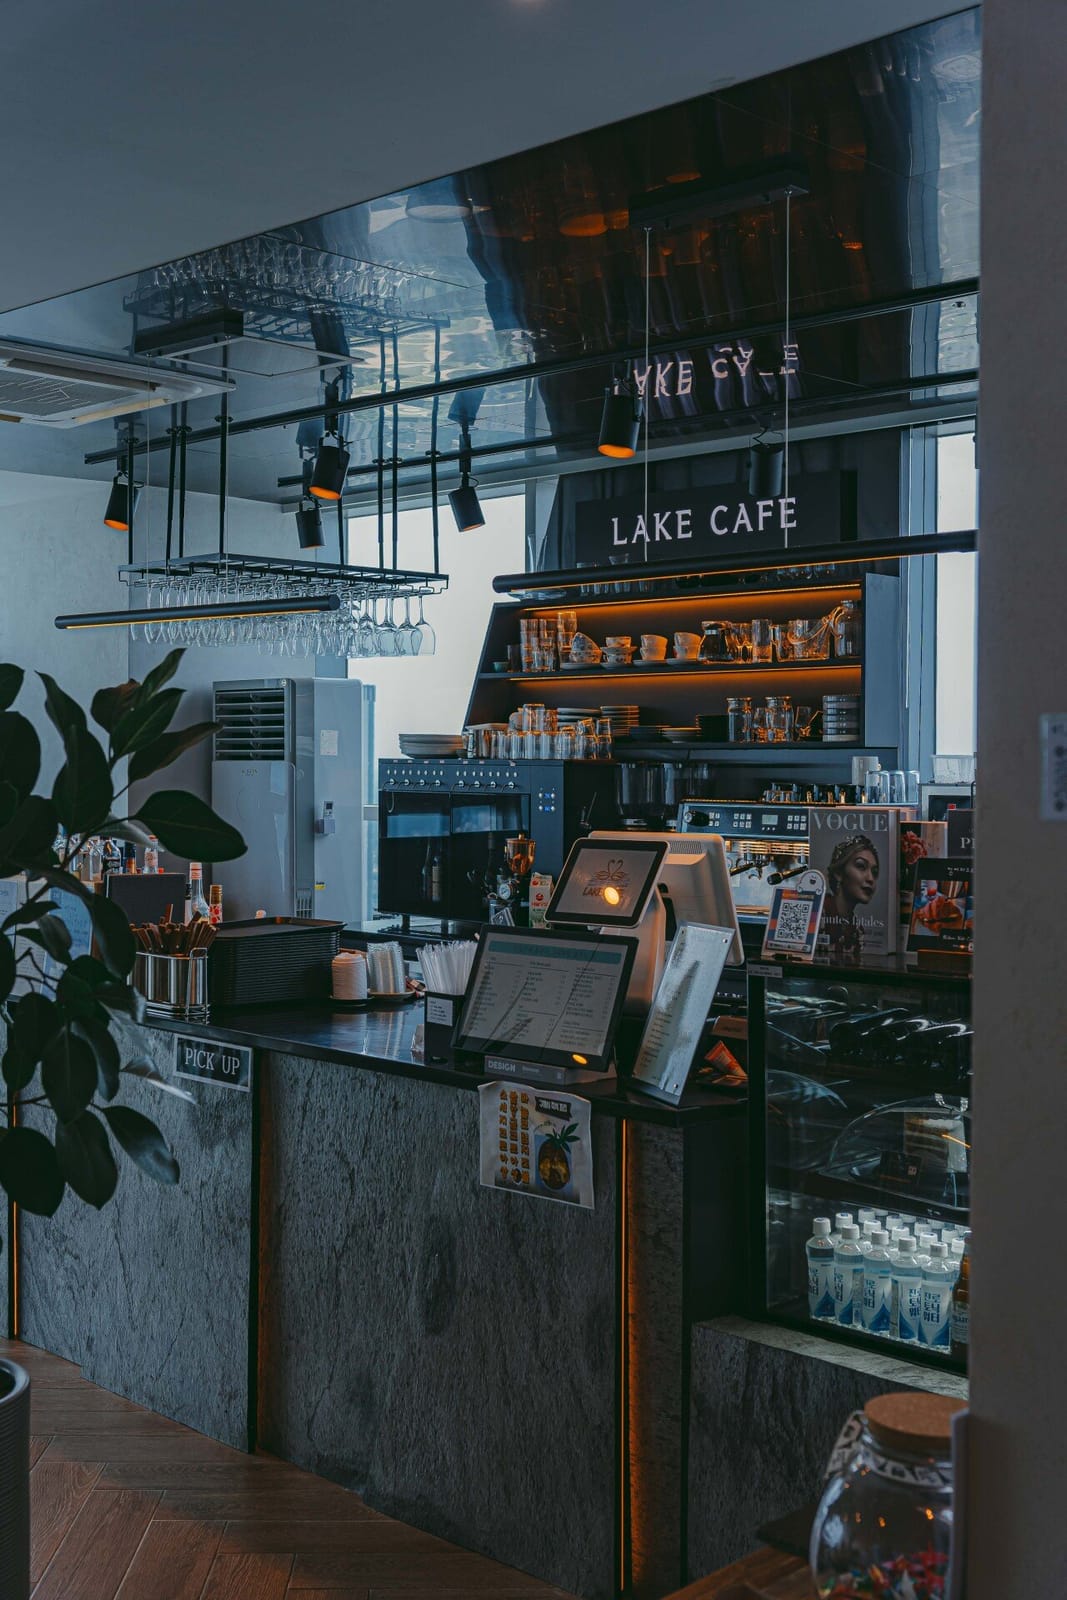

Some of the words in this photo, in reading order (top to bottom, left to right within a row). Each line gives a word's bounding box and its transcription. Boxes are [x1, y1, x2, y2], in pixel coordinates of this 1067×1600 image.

[611, 509, 692, 545] LAKE
[709, 497, 797, 536] CAFE
[812, 811, 888, 832] VOGUE
[184, 1047, 215, 1071] PICK
[221, 1055, 240, 1075] UP
[487, 1060, 516, 1073] DESIGN
